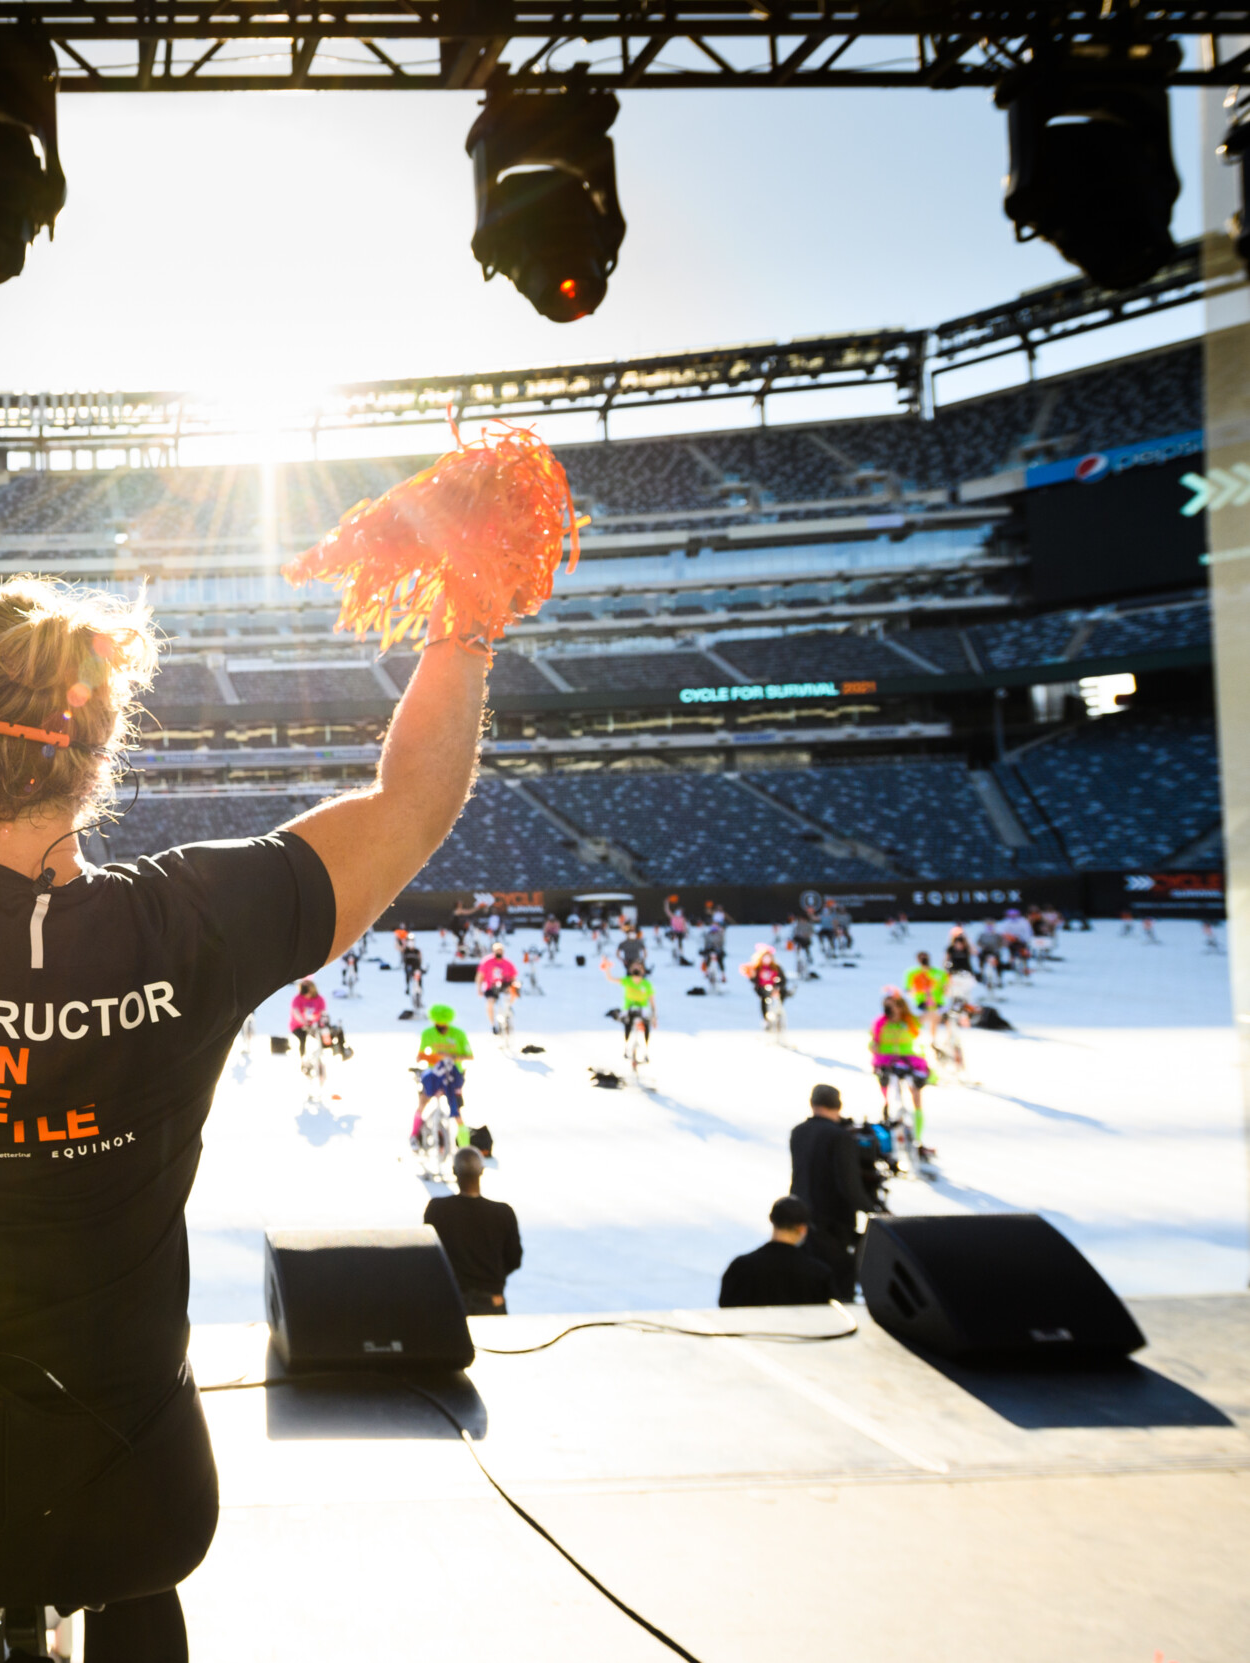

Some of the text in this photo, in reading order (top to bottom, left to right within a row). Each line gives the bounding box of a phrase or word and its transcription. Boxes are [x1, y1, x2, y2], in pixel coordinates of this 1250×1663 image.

[1112, 440, 1203, 476] peps
[679, 687, 729, 703] CYCLE
[731, 686, 764, 700] FOR
[765, 682, 840, 699] SURVIVAL
[912, 889, 1021, 906] EQUINOX
[51, 1131, 136, 1158] EQUINOX
